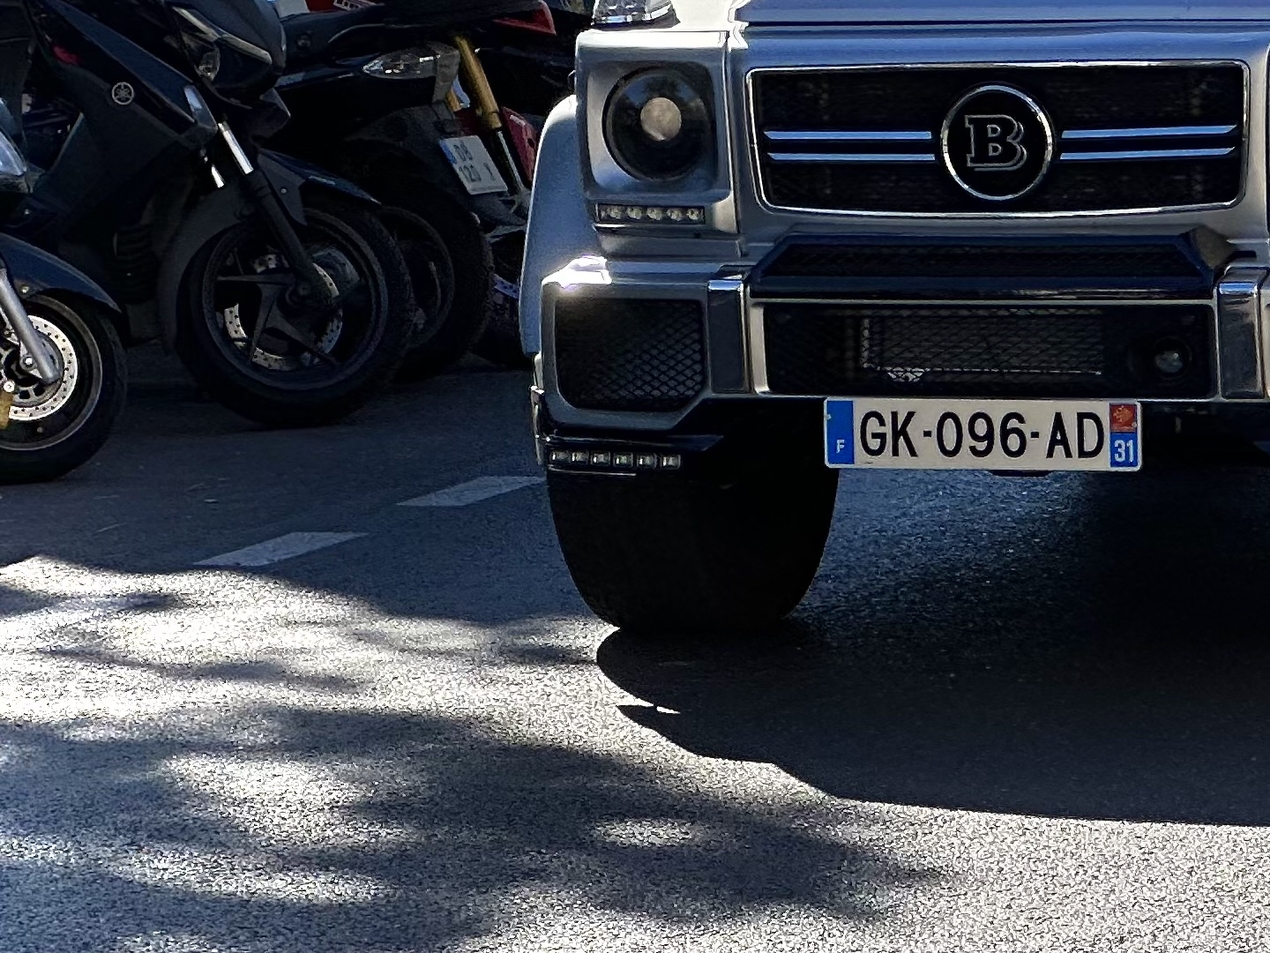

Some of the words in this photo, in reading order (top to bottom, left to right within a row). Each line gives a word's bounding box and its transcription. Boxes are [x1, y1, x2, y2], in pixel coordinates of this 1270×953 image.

[835, 439, 846, 454] F
[859, 410, 1106, 460] GK-096-AD
[1113, 439, 1135, 463] 31
